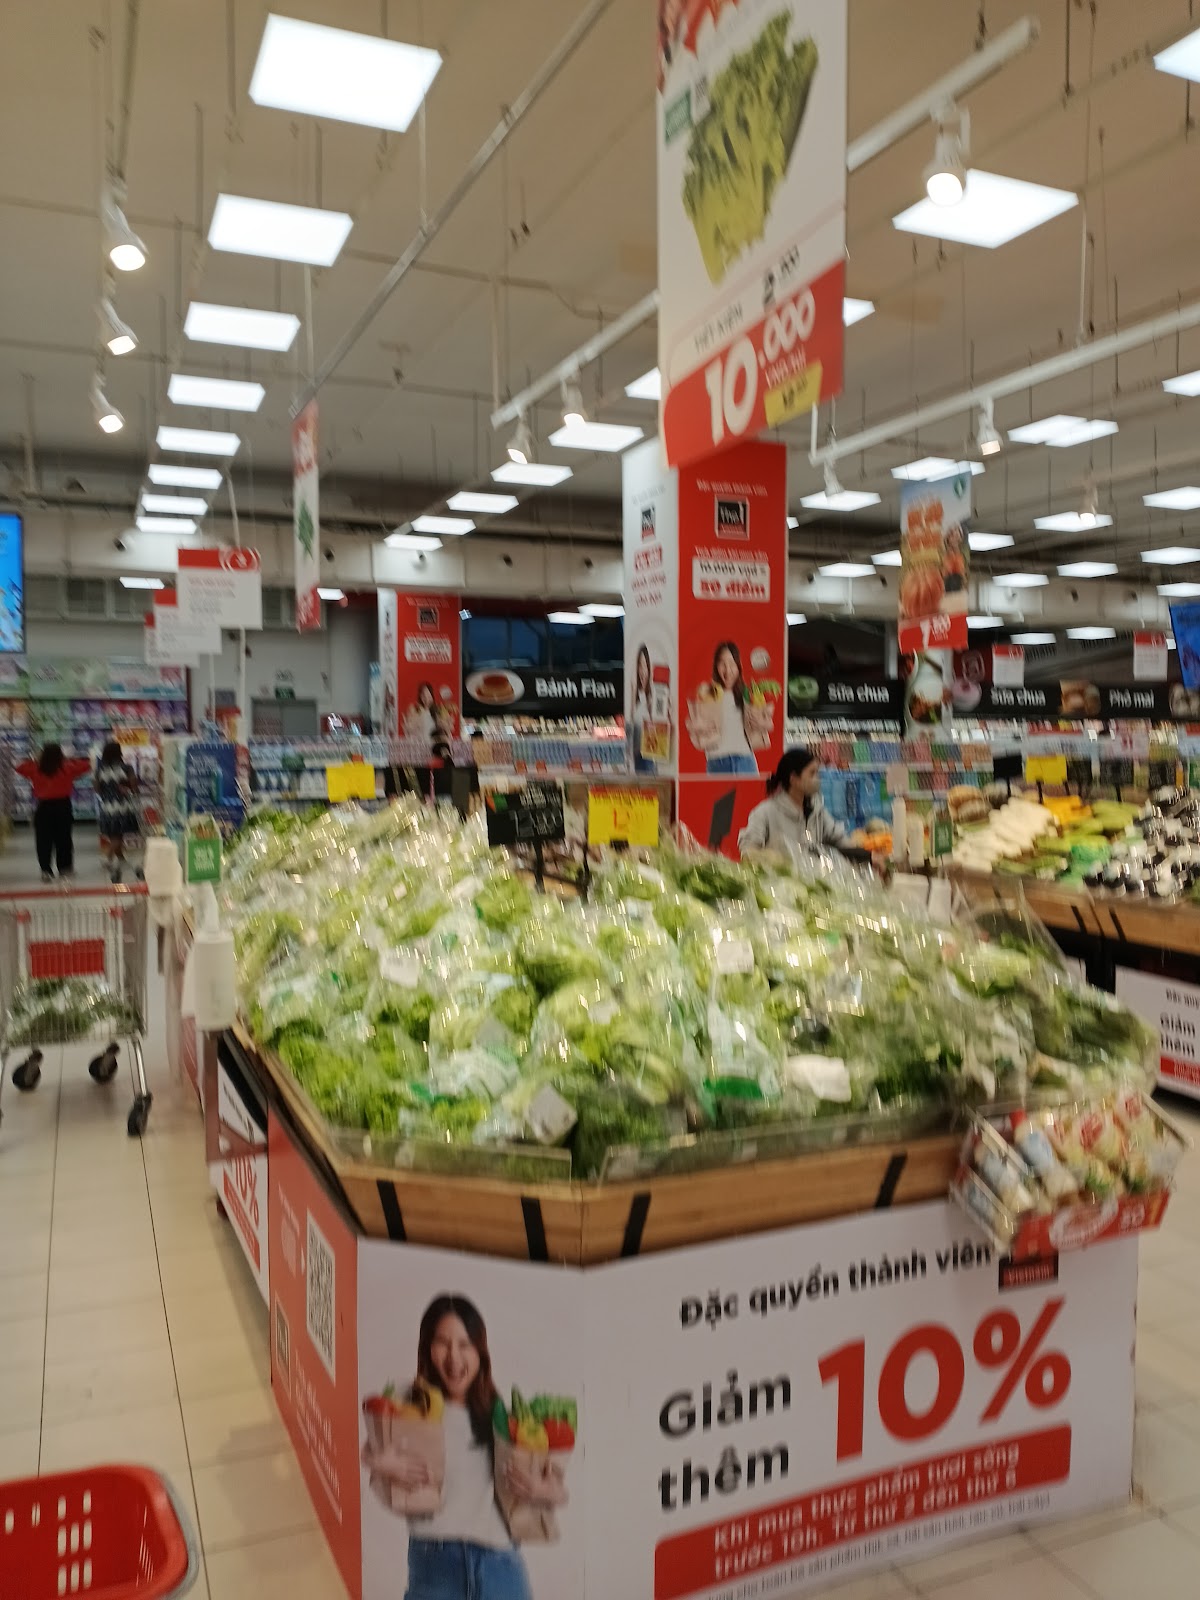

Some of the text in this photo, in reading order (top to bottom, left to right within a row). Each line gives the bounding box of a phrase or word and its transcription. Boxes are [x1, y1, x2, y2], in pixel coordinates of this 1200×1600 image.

[704, 287, 816, 447] 10.000
[535, 676, 616, 699] Bánh Flan
[828, 682, 890, 703] Sữa chua
[1016, 685, 1046, 706] chua
[680, 1290, 738, 1331] Đặc
[935, 1239, 992, 1274] viên
[658, 1369, 792, 1440] Giảm
[818, 1296, 1072, 1465] 10%
[658, 1442, 790, 1513] thêm
[714, 1517, 749, 1553] Khi
[758, 1505, 803, 1540] mua
